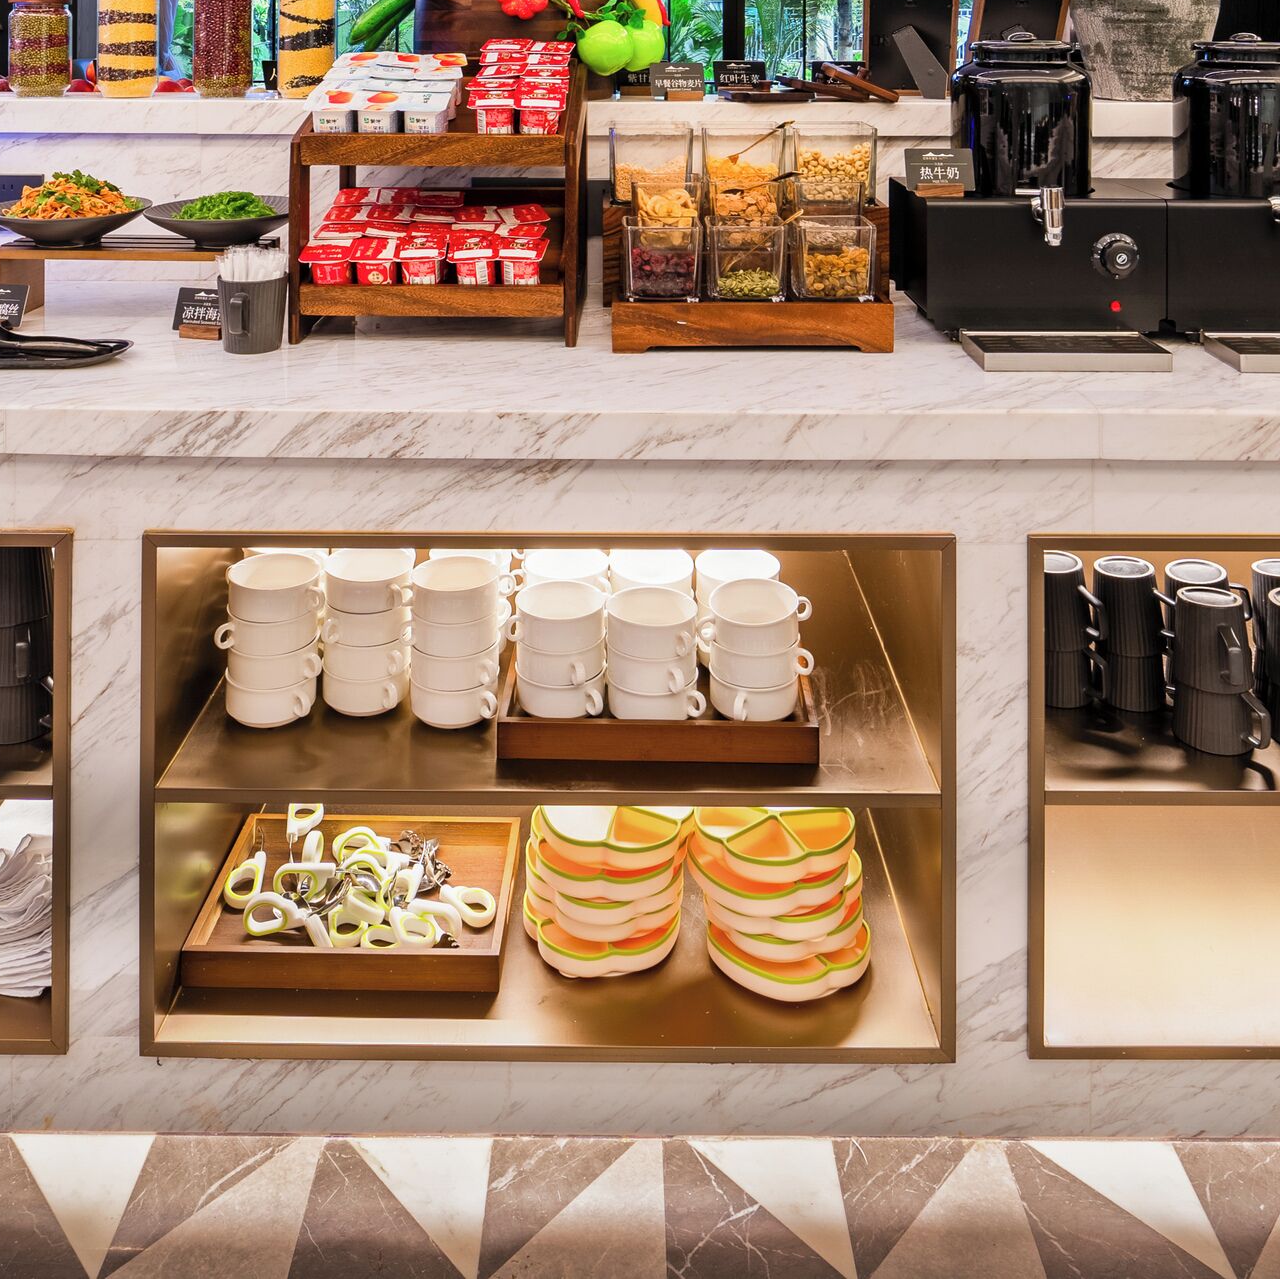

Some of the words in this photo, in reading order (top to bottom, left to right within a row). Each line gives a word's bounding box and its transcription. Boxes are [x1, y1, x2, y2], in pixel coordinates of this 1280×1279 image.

[628, 73, 650, 83] 紫甘
[655, 78, 703, 88] 早餐谷物麦片
[719, 73, 760, 84] 红叶生菜
[919, 166, 960, 180] 热牛奶
